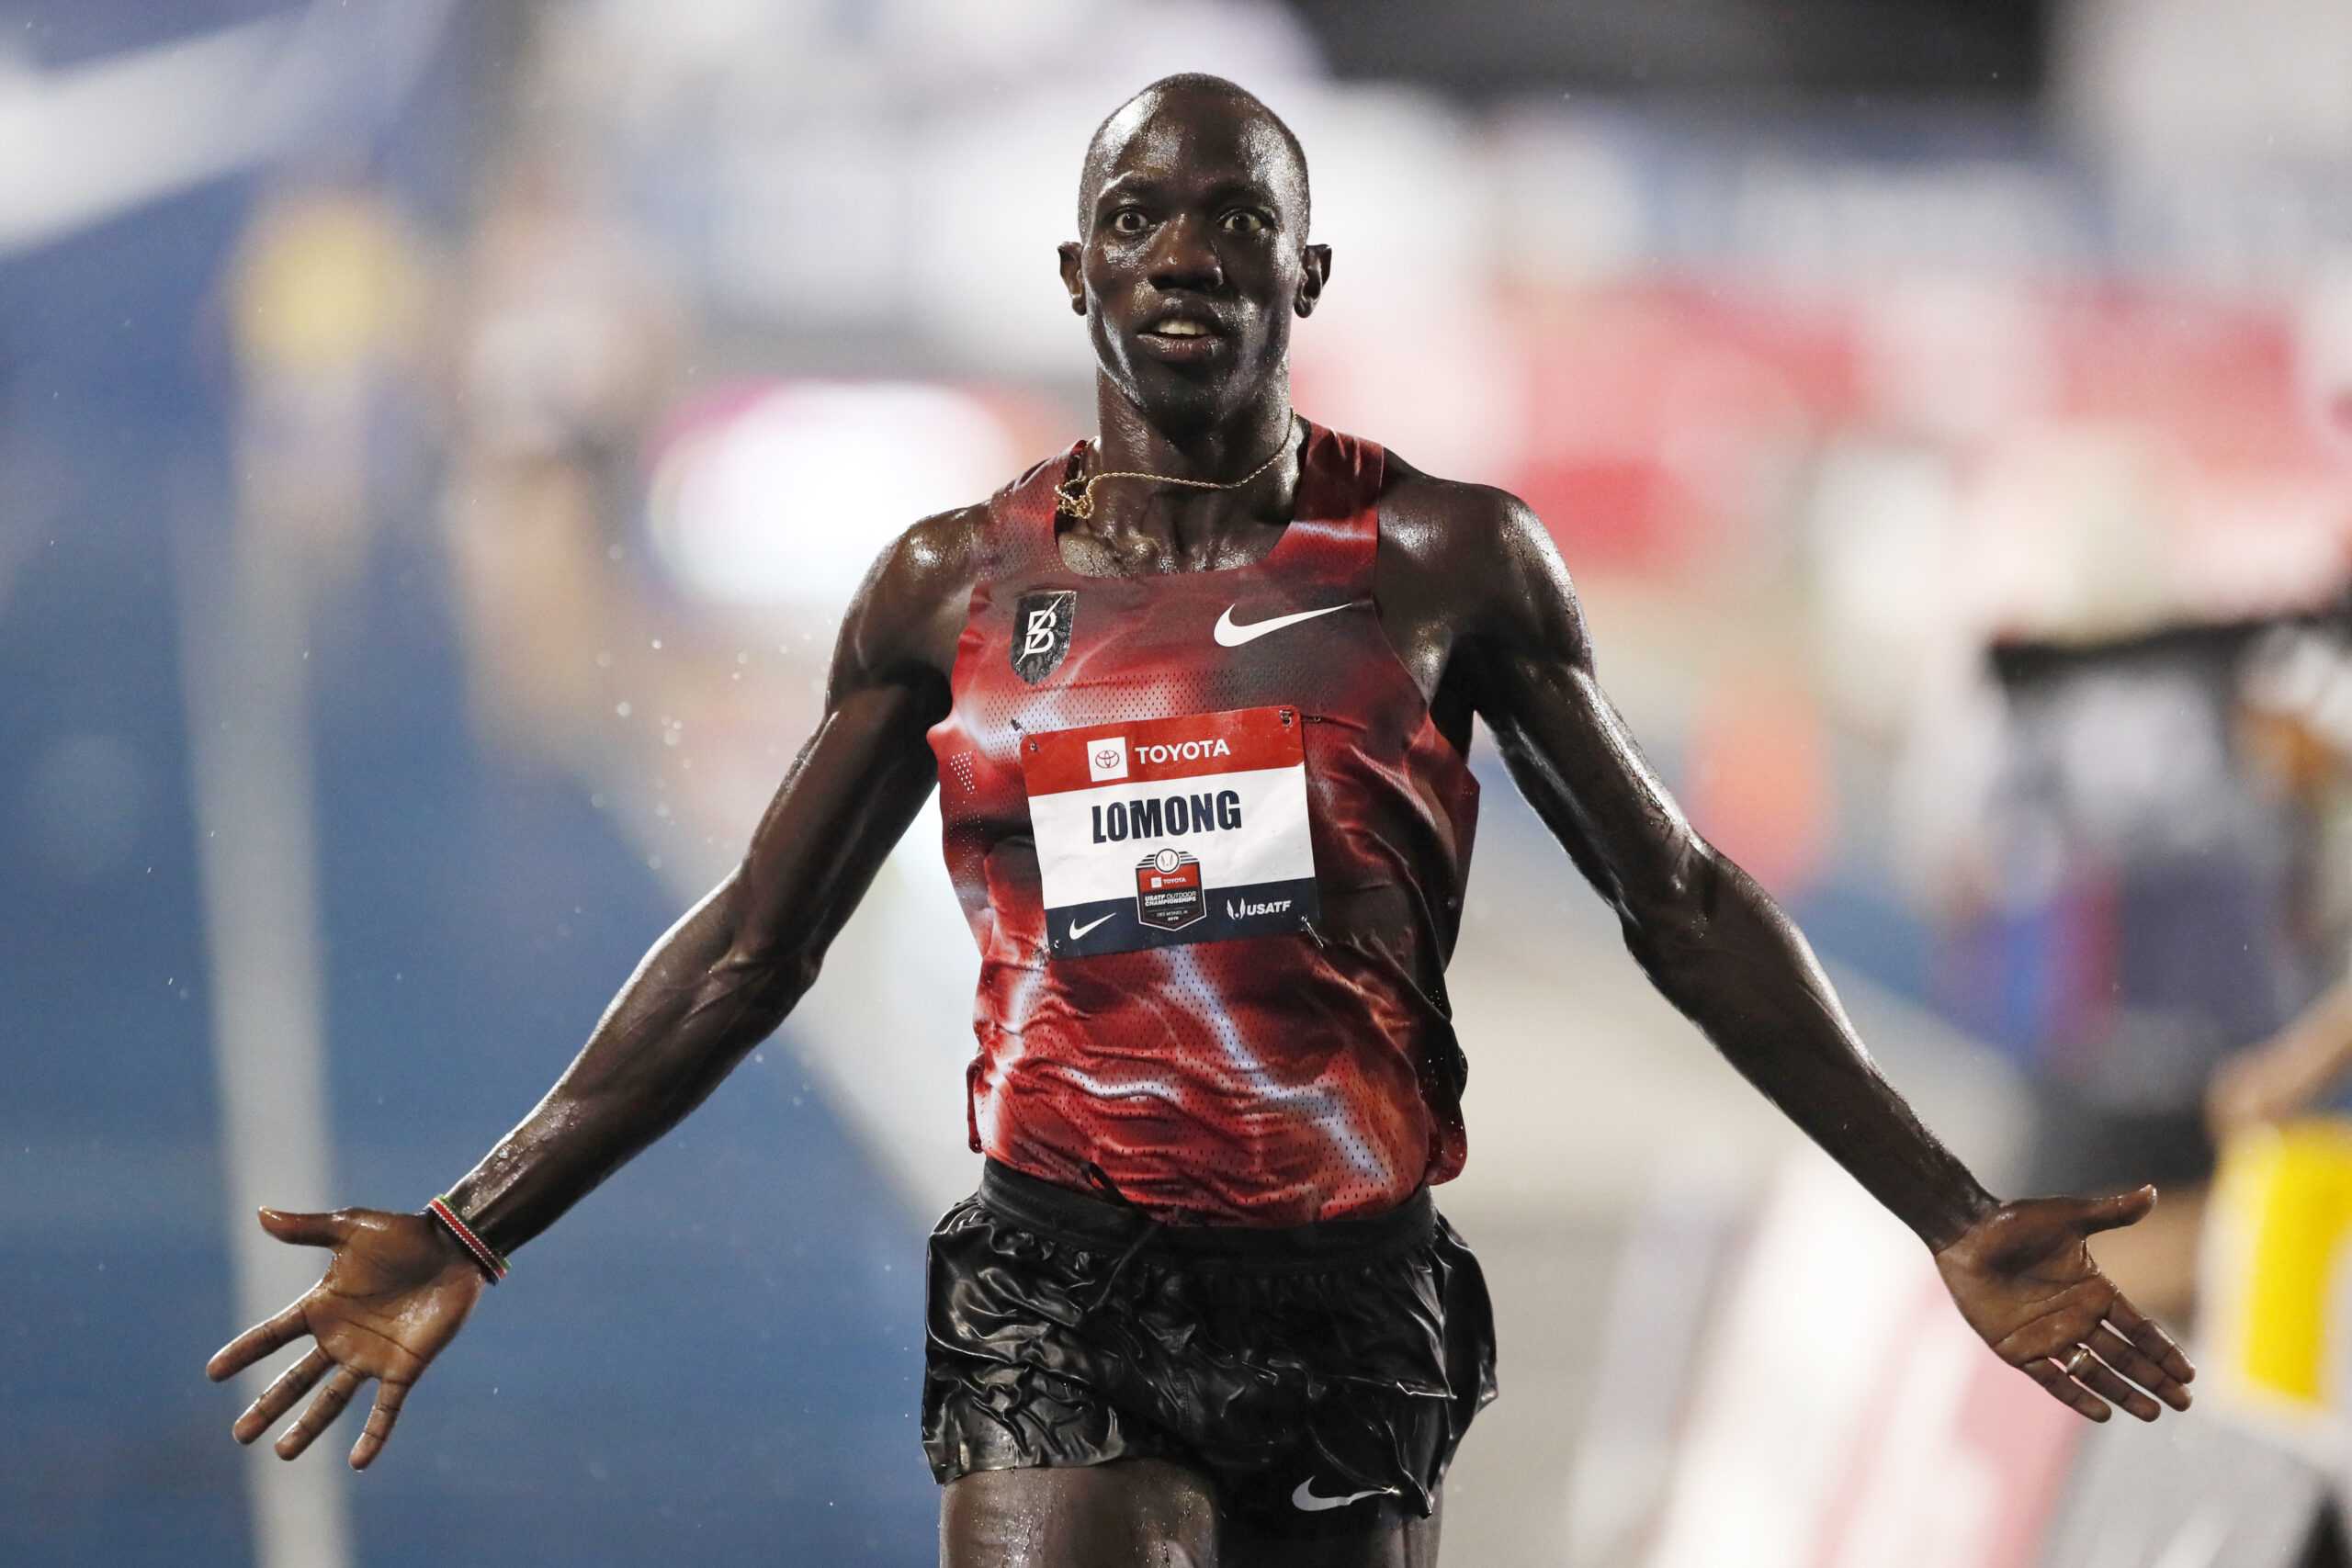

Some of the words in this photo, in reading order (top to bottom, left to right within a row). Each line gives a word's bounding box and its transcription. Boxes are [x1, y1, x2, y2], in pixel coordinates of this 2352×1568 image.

[1135, 739, 1231, 764] TOYOTA
[1091, 789, 1242, 843] LOMONG
[1144, 894, 1166, 902] USATF
[1166, 891, 1196, 899] OUTDOOR
[1144, 897, 1196, 907] CHAMPIONSHIPS
[1246, 899, 1292, 917] USATF
